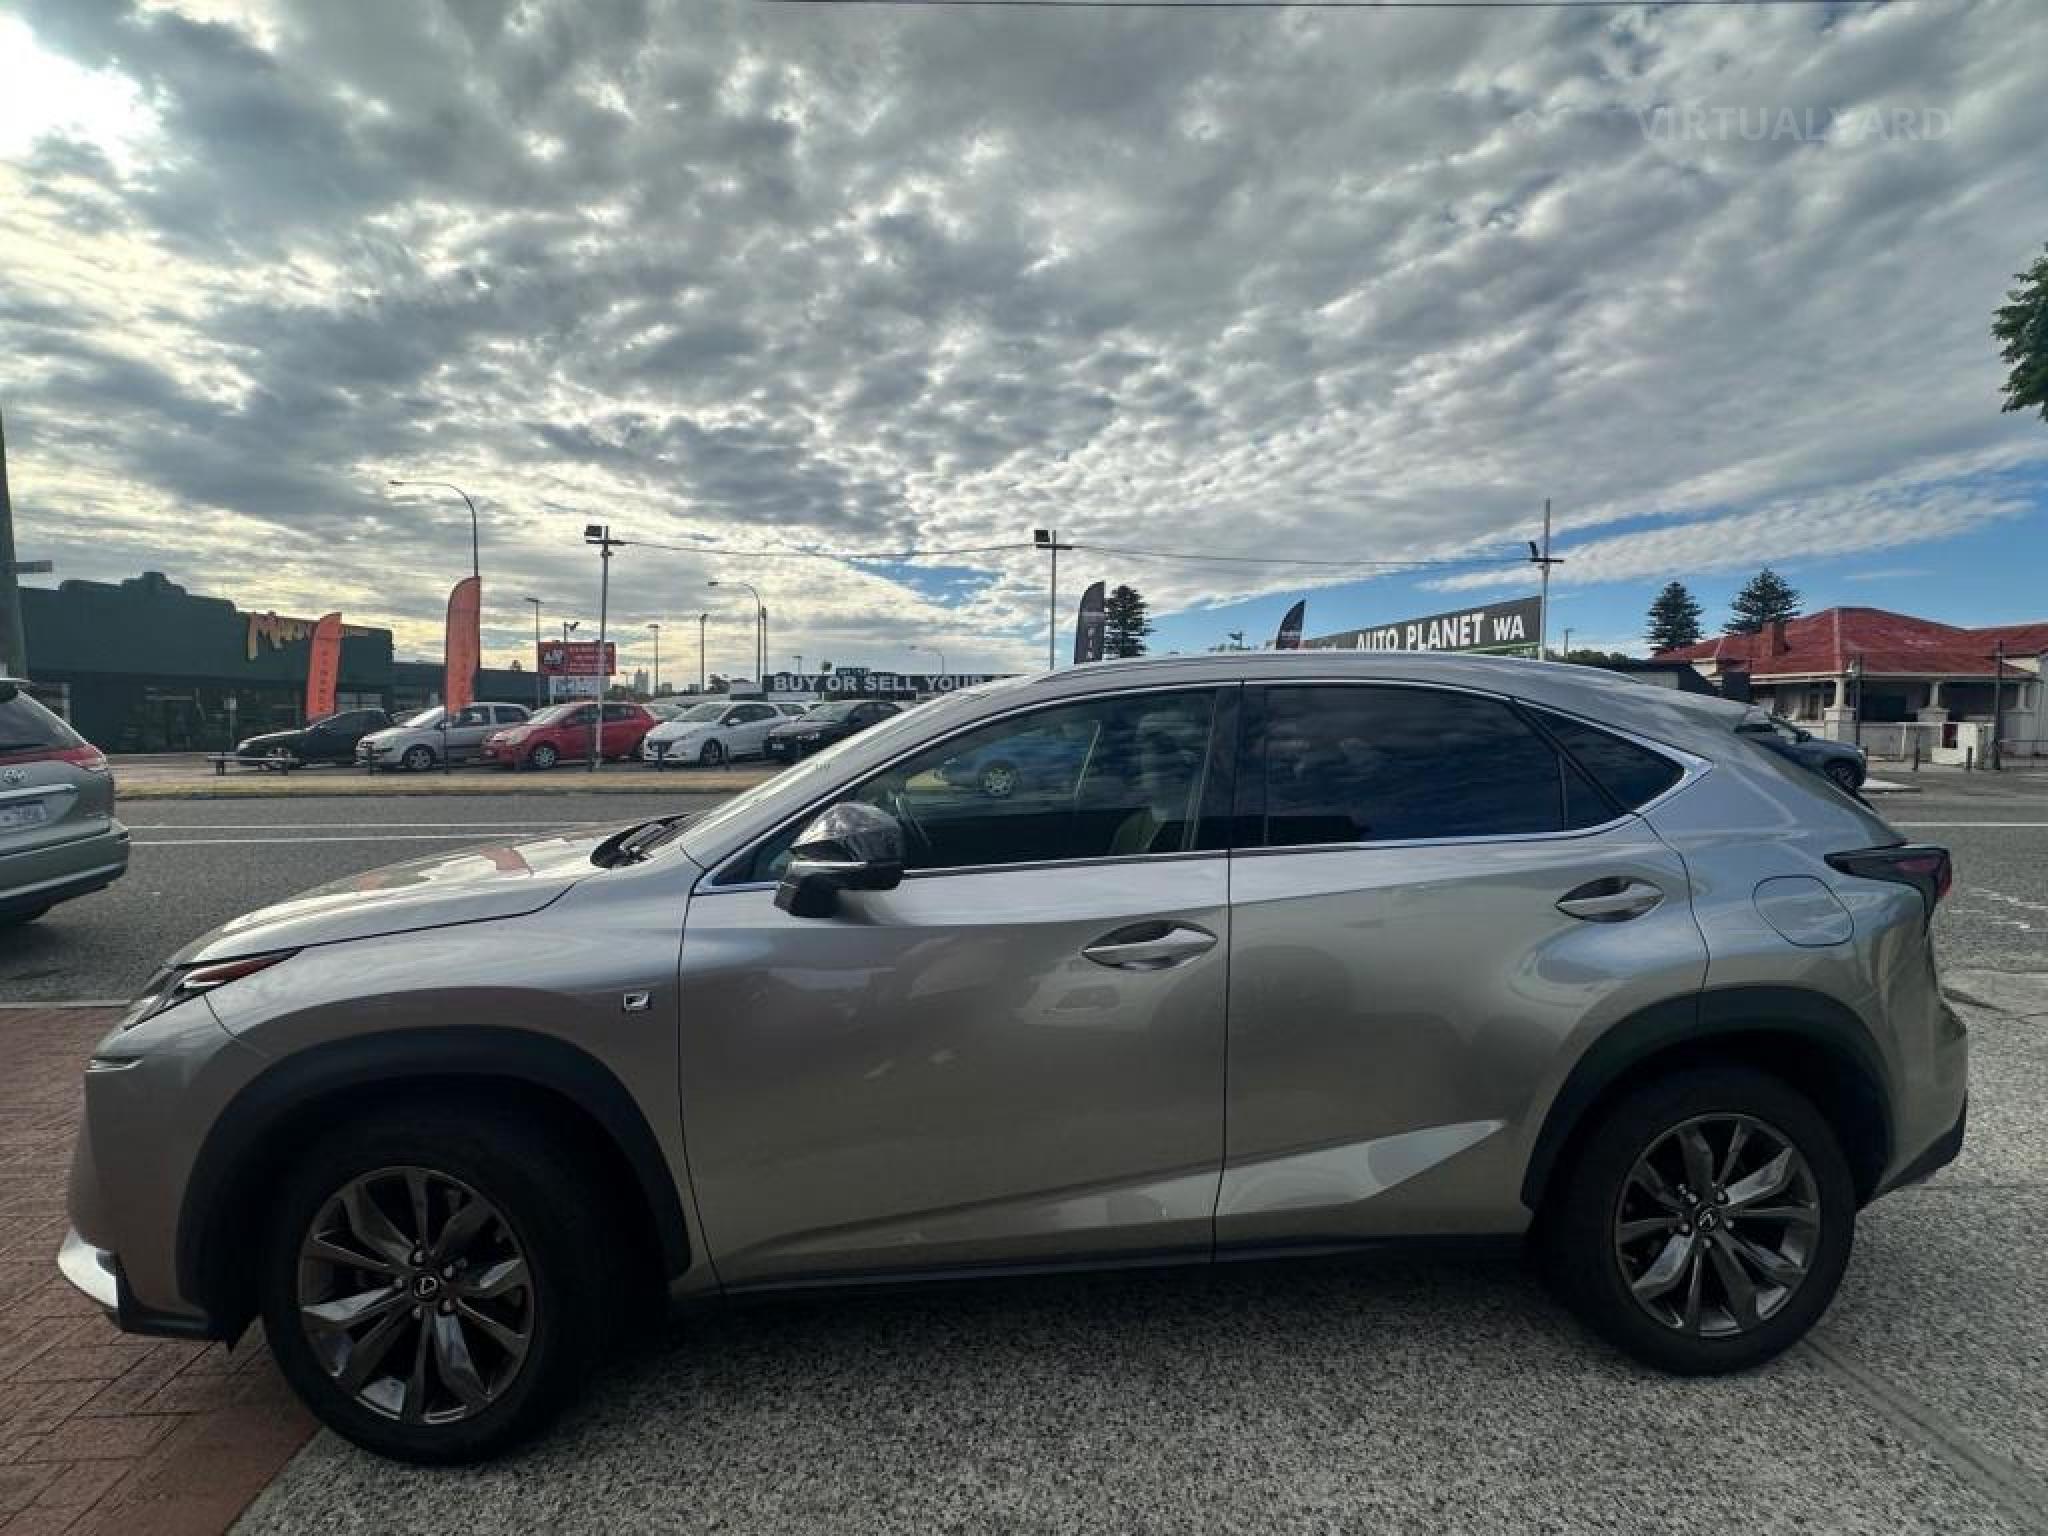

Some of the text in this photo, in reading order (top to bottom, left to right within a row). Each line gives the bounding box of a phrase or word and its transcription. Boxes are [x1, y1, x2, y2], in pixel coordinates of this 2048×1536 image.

[1356, 613, 1525, 650] AUTO PLANET WA
[773, 675, 818, 691] BUY
[827, 675, 858, 691] OR
[865, 675, 918, 691] SELL
